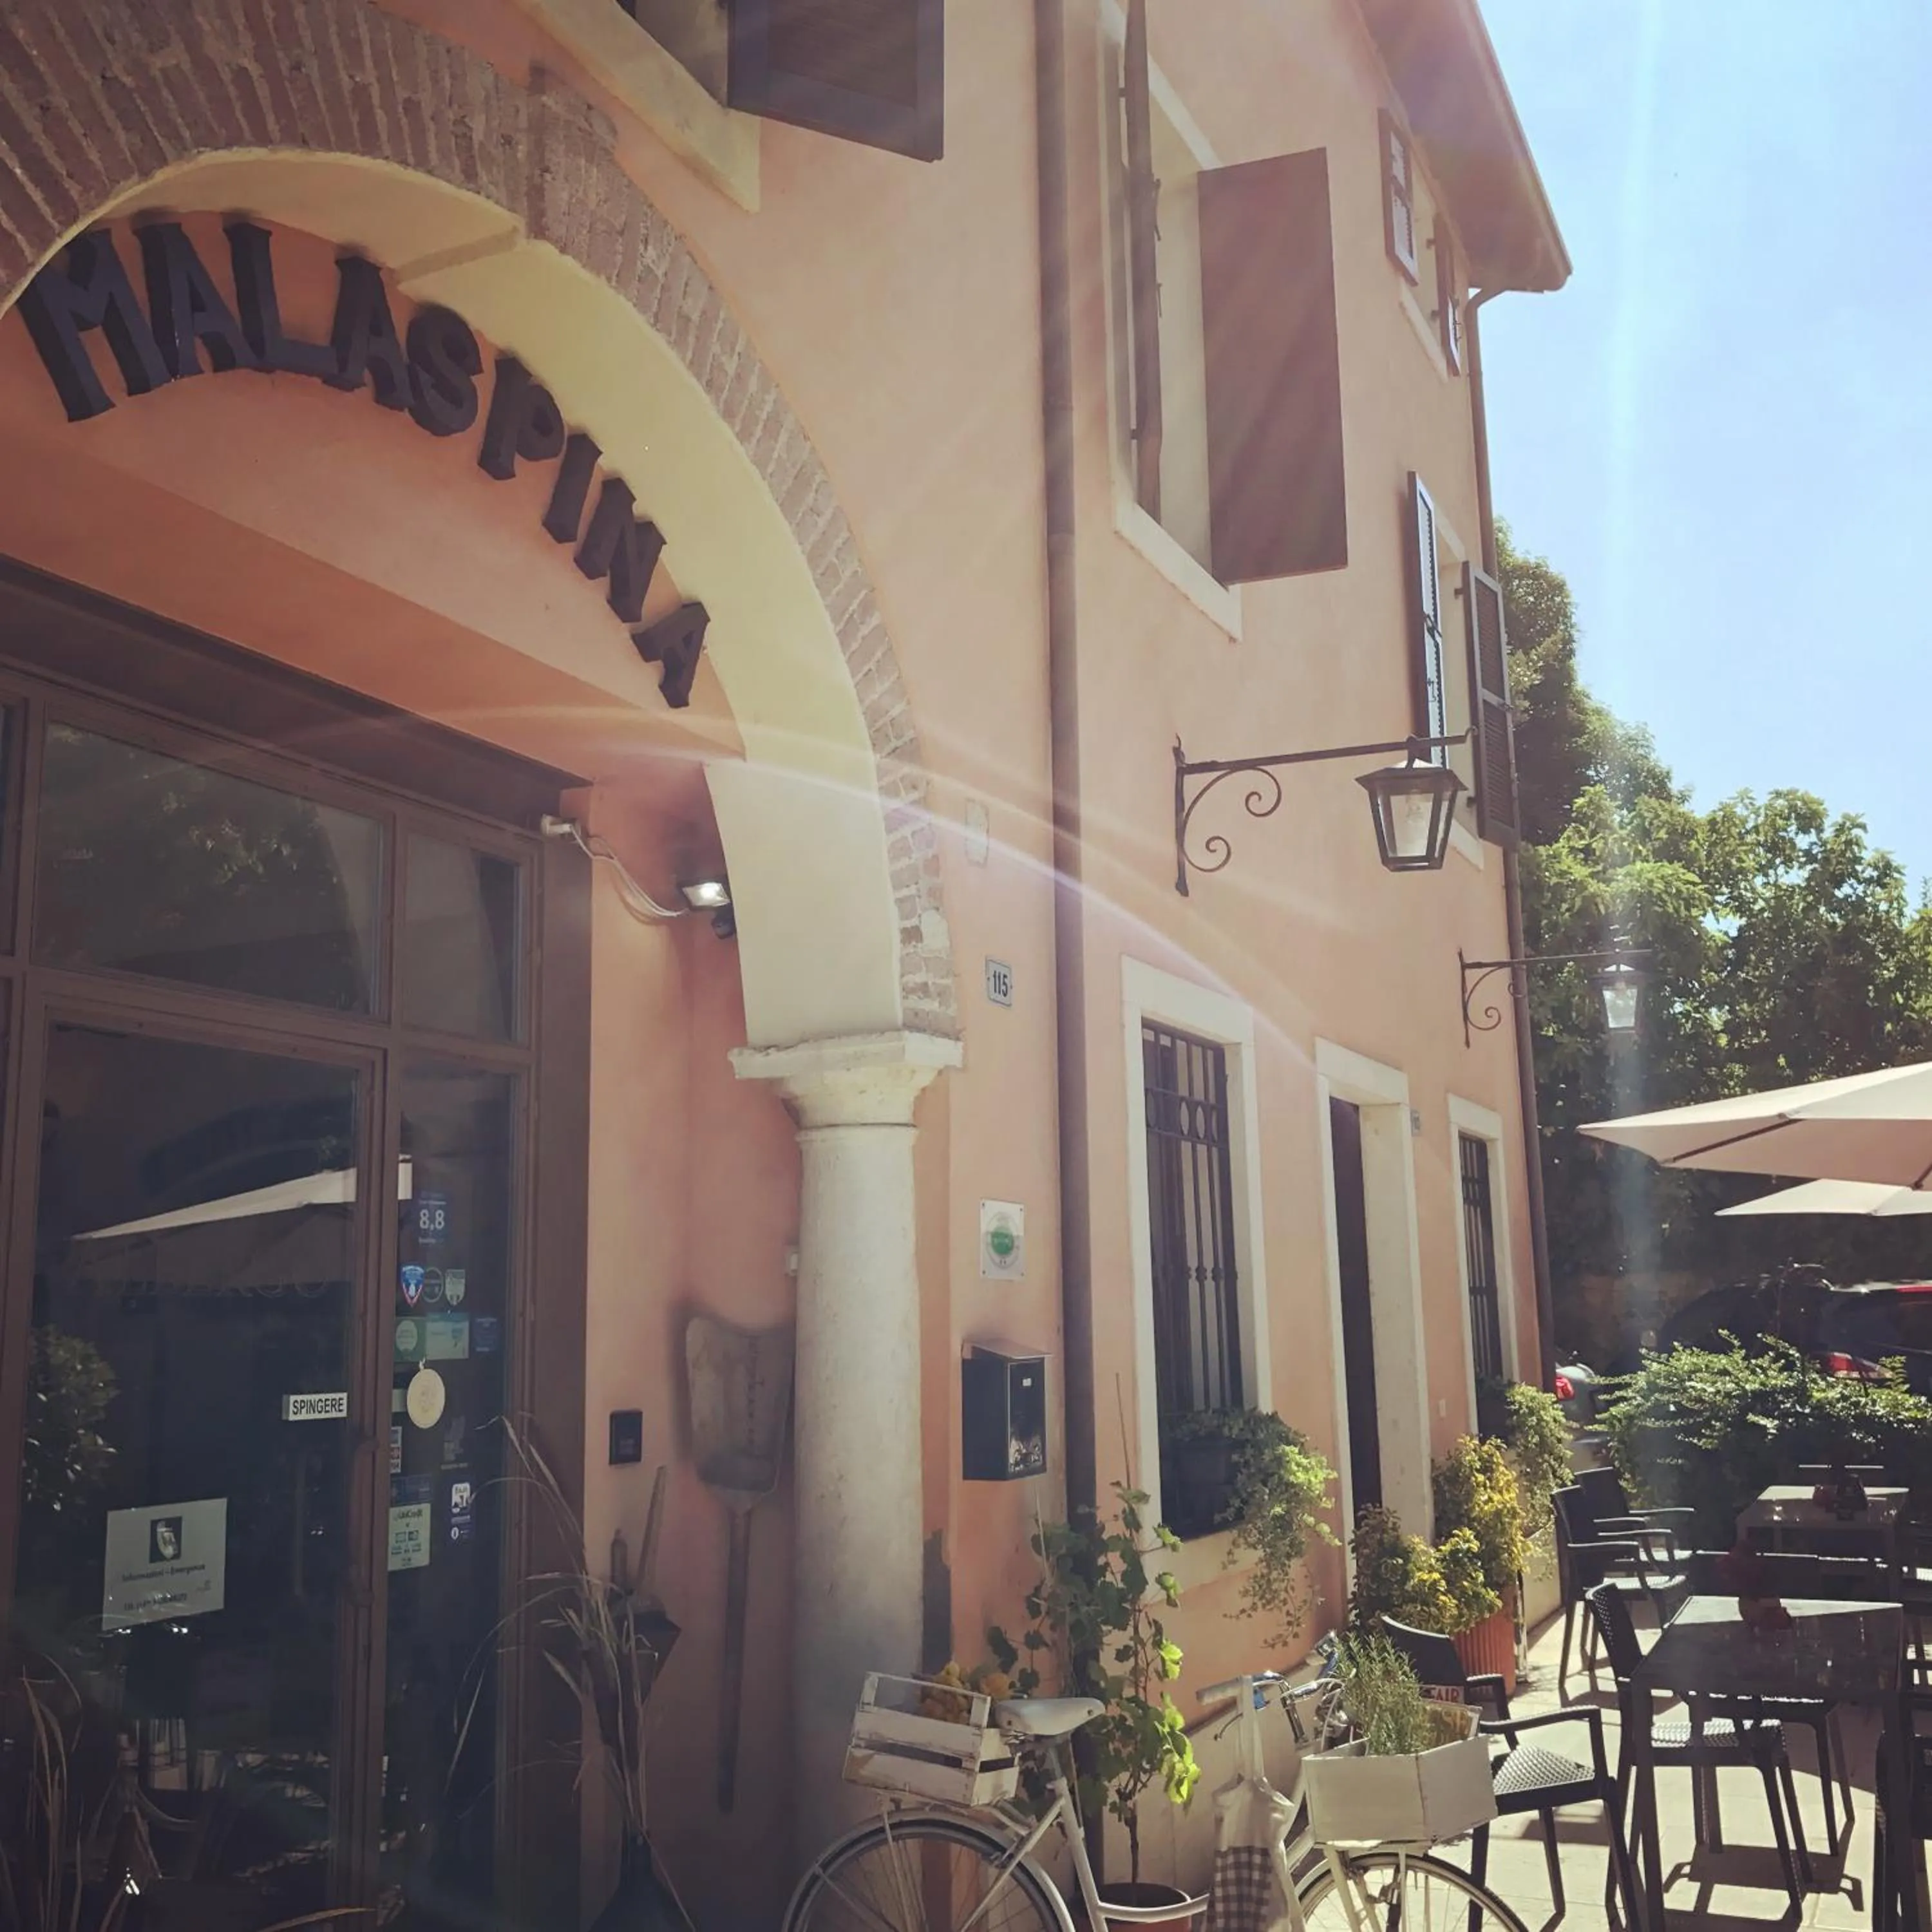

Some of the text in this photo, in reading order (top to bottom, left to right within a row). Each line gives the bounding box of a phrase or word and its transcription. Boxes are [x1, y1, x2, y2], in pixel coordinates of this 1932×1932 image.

[16, 221, 710, 708] MALASPINA
[992, 970, 1009, 998] 115
[419, 1209, 445, 1231] 8,8
[292, 1397, 344, 1416] SPINGERE
